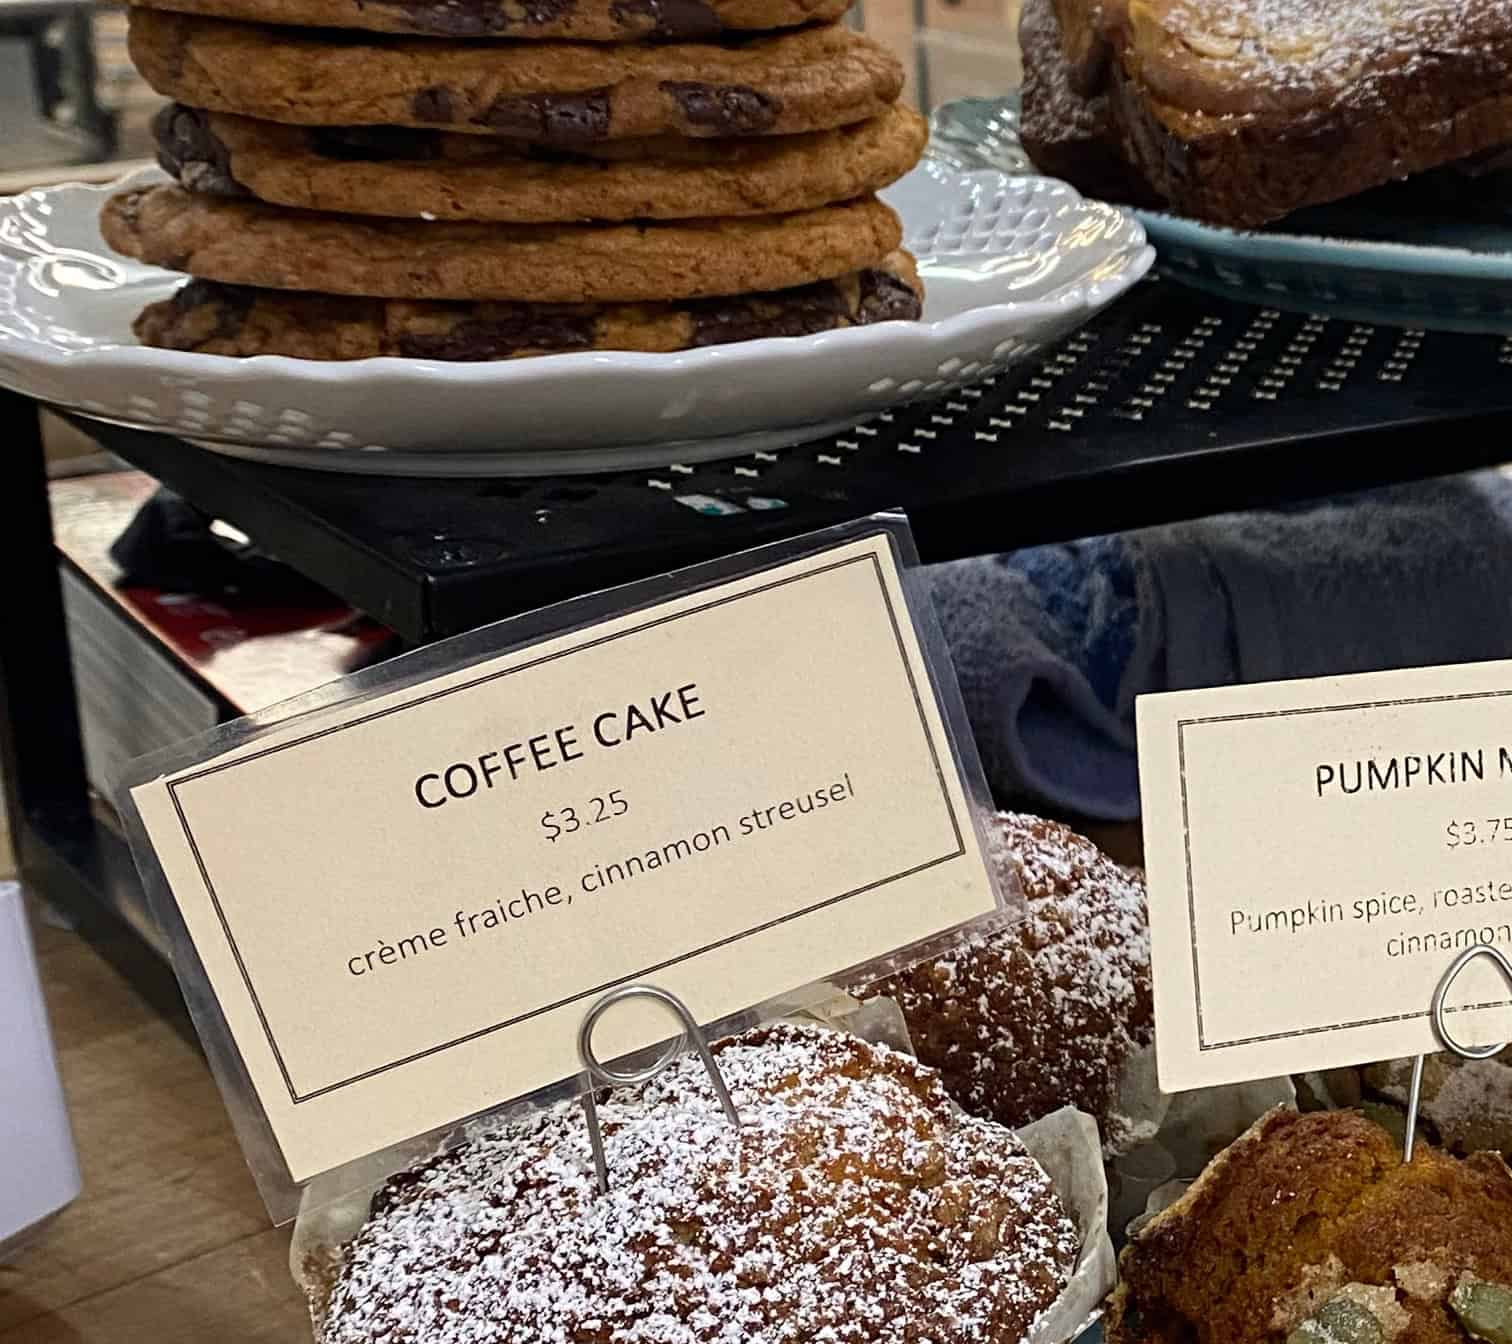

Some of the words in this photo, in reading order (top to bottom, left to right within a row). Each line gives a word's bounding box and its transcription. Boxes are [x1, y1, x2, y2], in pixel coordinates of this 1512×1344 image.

[414, 726, 584, 810] COFFEE
[593, 683, 705, 748] CAKE
[1317, 749, 1484, 796] PUMPKIN
[541, 790, 629, 843] $3.25
[346, 920, 448, 978] crème
[454, 883, 575, 940] fraiche,
[581, 827, 730, 895] cinnamon
[739, 774, 855, 836] streusel
[1230, 897, 1343, 936] Pumpkin
[1353, 889, 1424, 922] spice,
[1387, 922, 1511, 959] cinnamon
